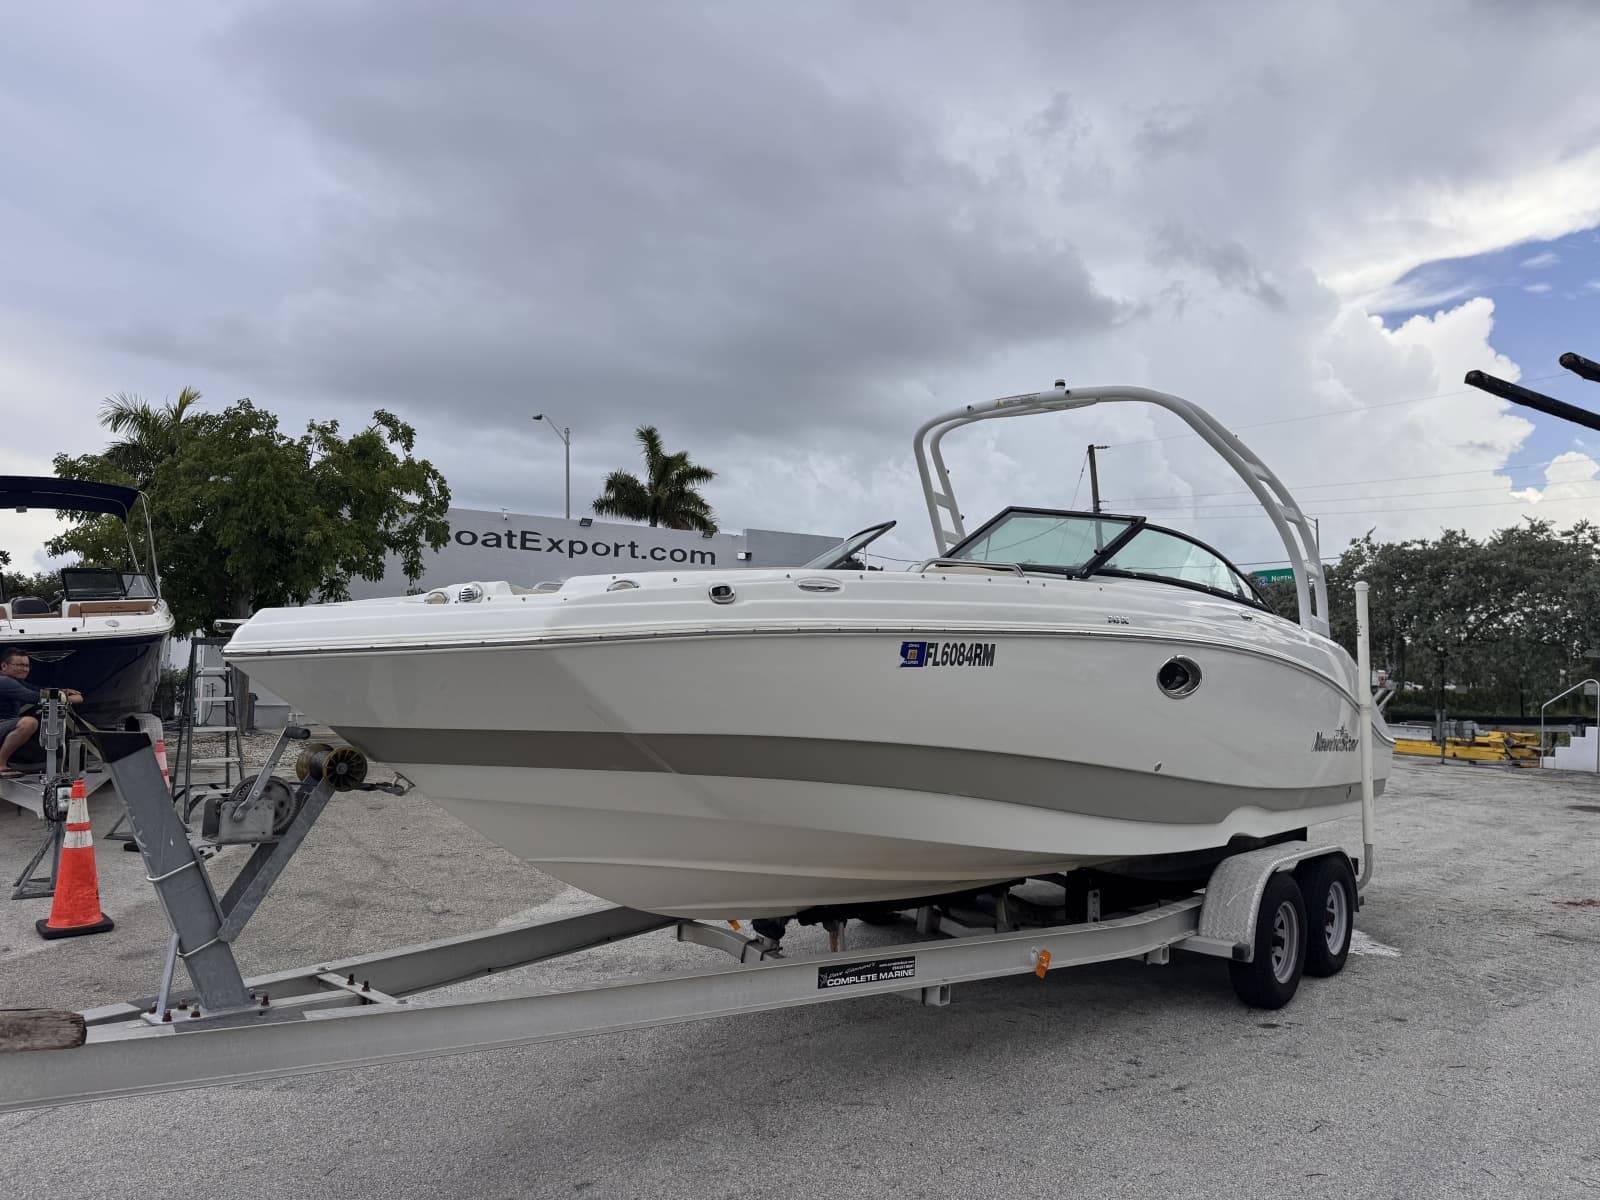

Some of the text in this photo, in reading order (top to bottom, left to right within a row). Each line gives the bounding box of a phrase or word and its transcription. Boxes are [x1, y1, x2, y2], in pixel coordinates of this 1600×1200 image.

[426, 527, 716, 566] oatExport.com
[924, 642, 996, 667] FL6084RM
[827, 973, 878, 987] COMPLETE
[879, 968, 915, 980] MARINE
